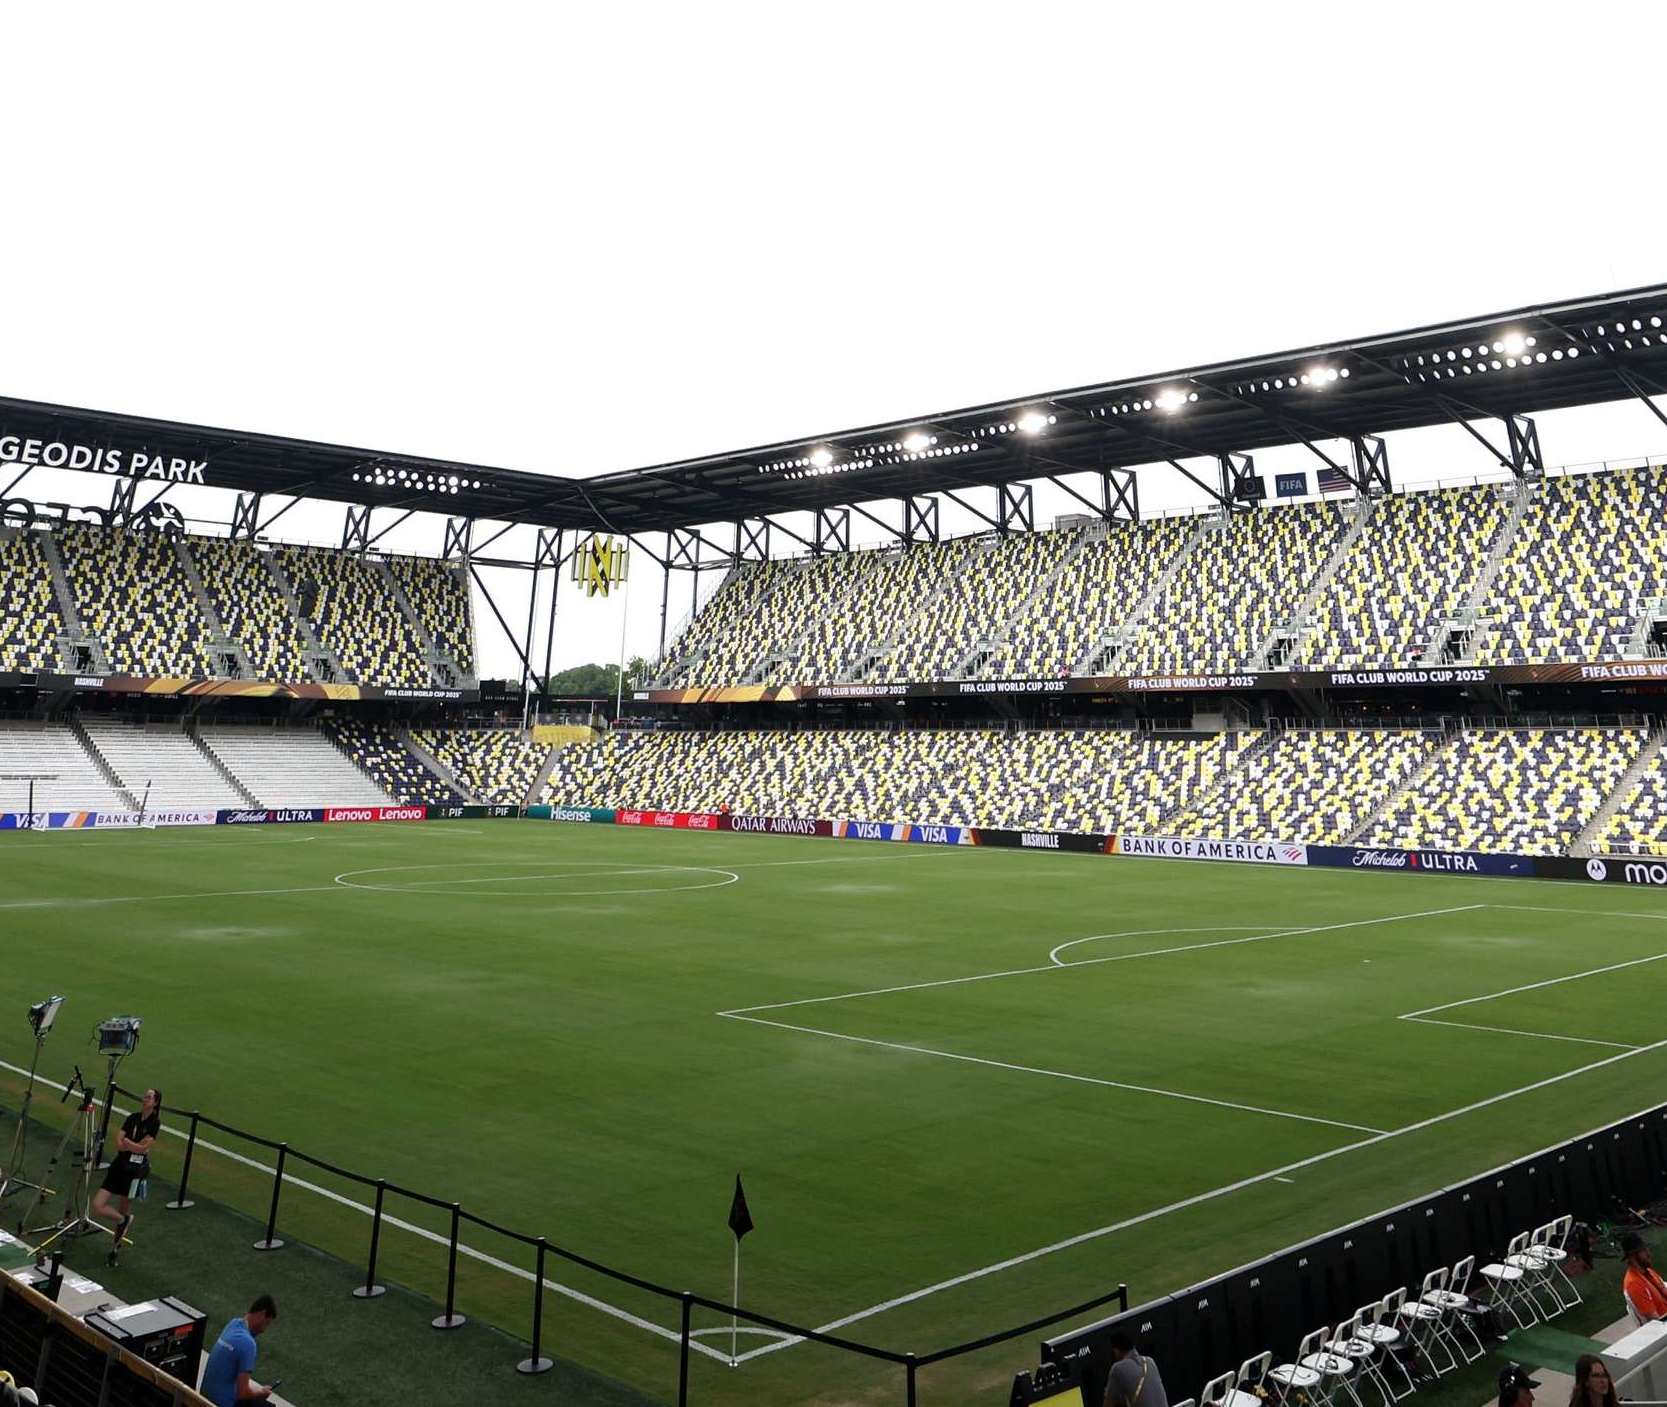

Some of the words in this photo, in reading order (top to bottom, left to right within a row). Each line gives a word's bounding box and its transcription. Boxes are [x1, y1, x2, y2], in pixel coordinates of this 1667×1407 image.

[128, 453, 208, 485] PARK
[1279, 480, 1303, 491] FIFA
[1332, 674, 1354, 684] FIFA
[1356, 673, 1384, 684] CLUB
[1386, 672, 1427, 683] WORLD
[1430, 671, 1453, 682] CUP
[1581, 666, 1610, 678] FIFA
[1612, 665, 1646, 678] CLUB
[74, 677, 104, 687] NASHVILLE
[959, 683, 976, 693] FIFA
[977, 683, 996, 692] CLUB
[997, 682, 1025, 692] WORLD
[1027, 682, 1043, 692] CUP
[1128, 679, 1148, 689] FIFA
[1149, 678, 1172, 688] CLUB
[1174, 677, 1207, 688] WORLD
[1209, 677, 1228, 687] CUP
[397, 689, 413, 697] CLUB
[413, 690, 433, 698] WORLD
[818, 687, 832, 696] FIFA
[832, 687, 849, 696] CLUB
[850, 686, 873, 695] WORLD
[874, 686, 888, 695] CUP
[227, 810, 269, 824] Michelob
[276, 810, 314, 822] ULTRA
[328, 809, 372, 821] Lenovo
[380, 808, 422, 820] Lenovo
[449, 808, 463, 817] PIF
[495, 808, 509, 816] PIF
[551, 807, 592, 822] Hisense
[97, 814, 129, 824] BANK
[149, 813, 200, 823] AMERICA
[732, 817, 766, 831] QATAR
[770, 818, 816, 834] AIRWAYS
[856, 823, 882, 839] VISA
[919, 826, 948, 843] VISA
[1021, 833, 1059, 849] NASHVILLE
[1123, 838, 1166, 854] BANK
[1171, 841, 1192, 857] OF
[1192, 843, 1277, 861] AMERICA
[1352, 850, 1406, 867] Michelob
[1422, 853, 1478, 871] ULTRA
